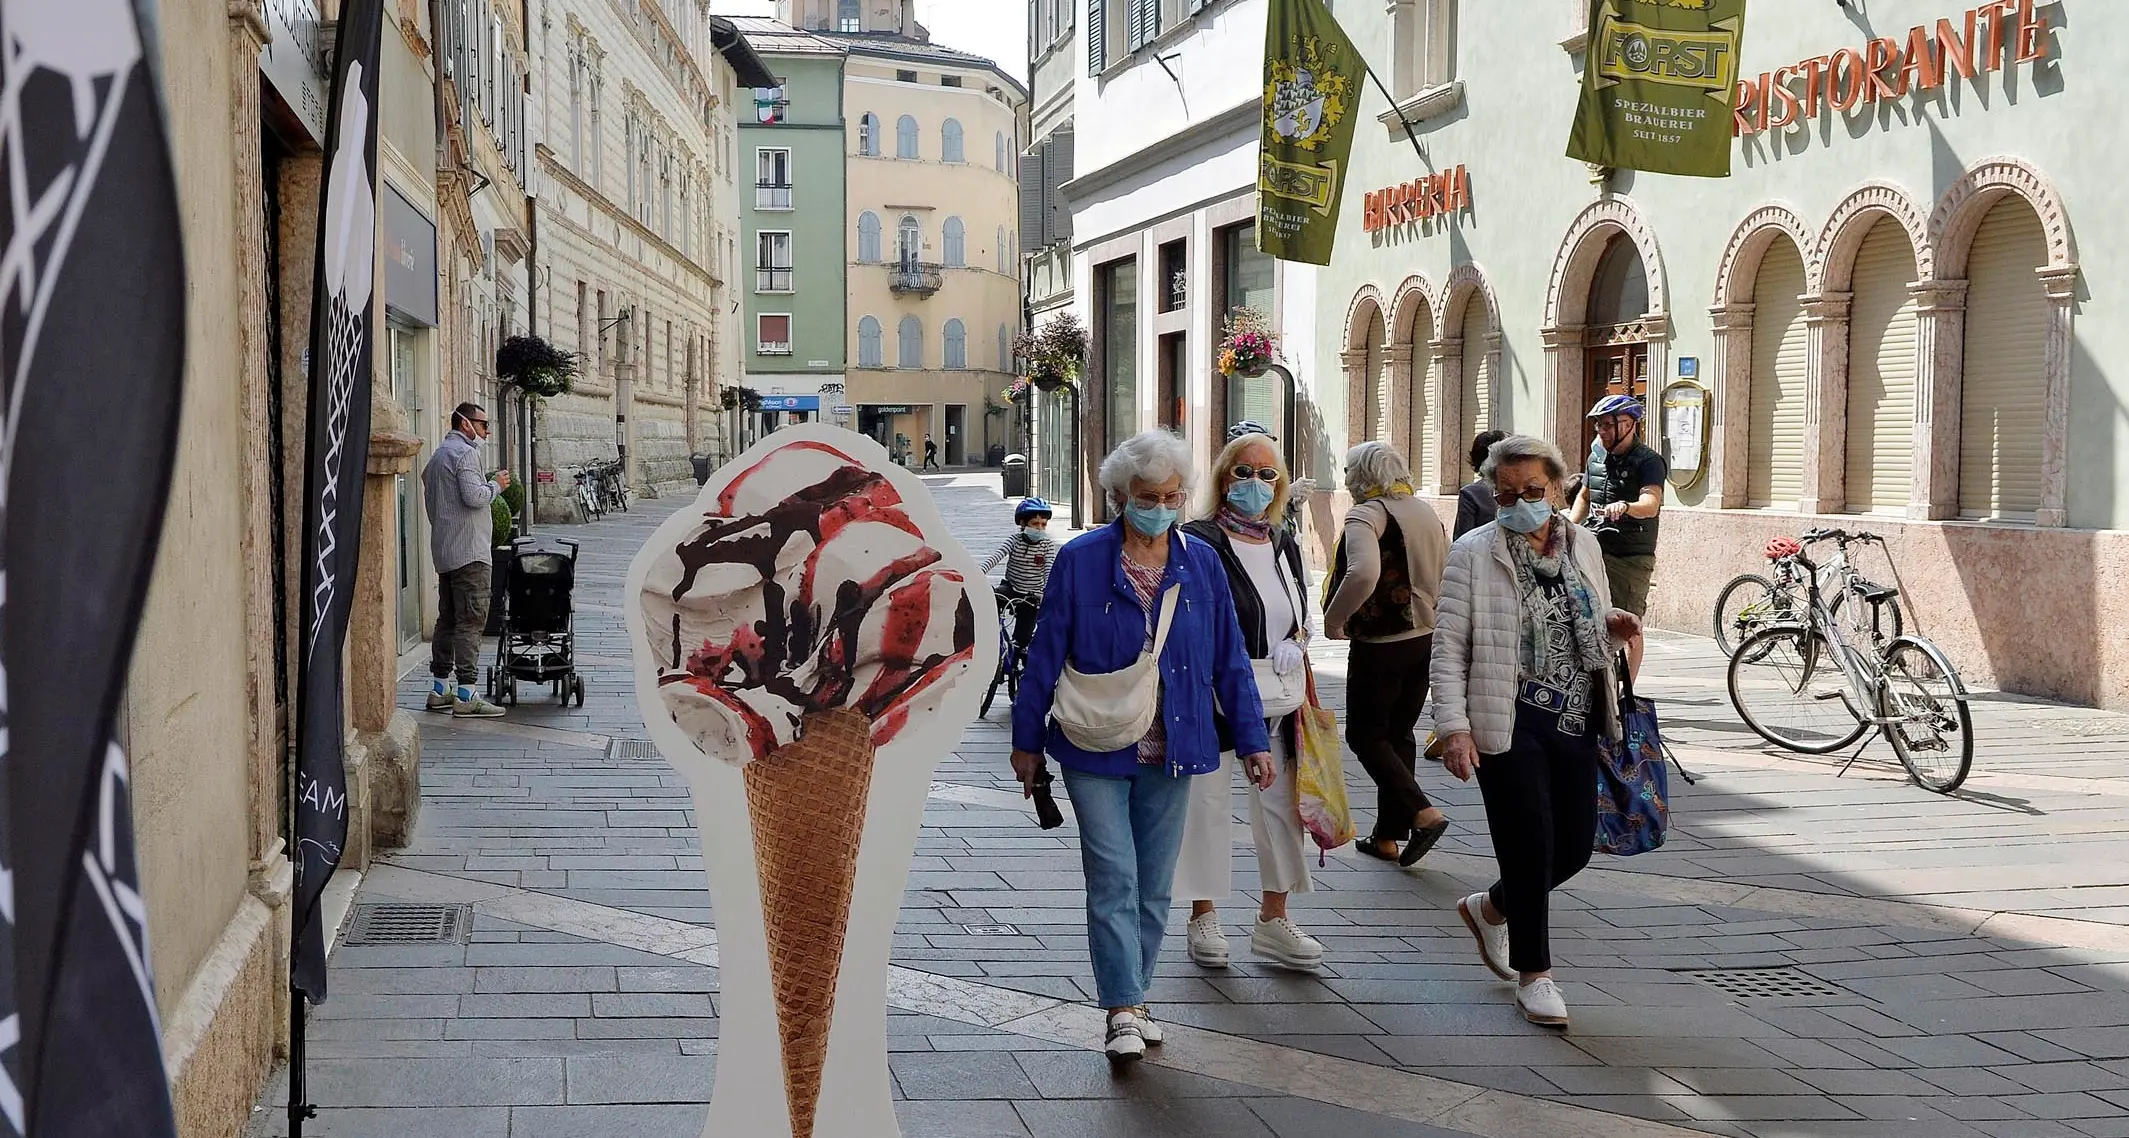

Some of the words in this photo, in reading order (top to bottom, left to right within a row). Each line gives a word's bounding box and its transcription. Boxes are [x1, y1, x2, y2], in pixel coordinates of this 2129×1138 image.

[1603, 31, 1729, 79] FORST
[1732, 0, 2047, 137] RISTORANTE
[1614, 98, 1706, 119] SPEZIALBIER
[1625, 112, 1694, 131] BRAUEREI
[1633, 129, 1657, 141] SEIT
[1658, 133, 1682, 144] 1857
[1363, 163, 1469, 233] BIRRERIA
